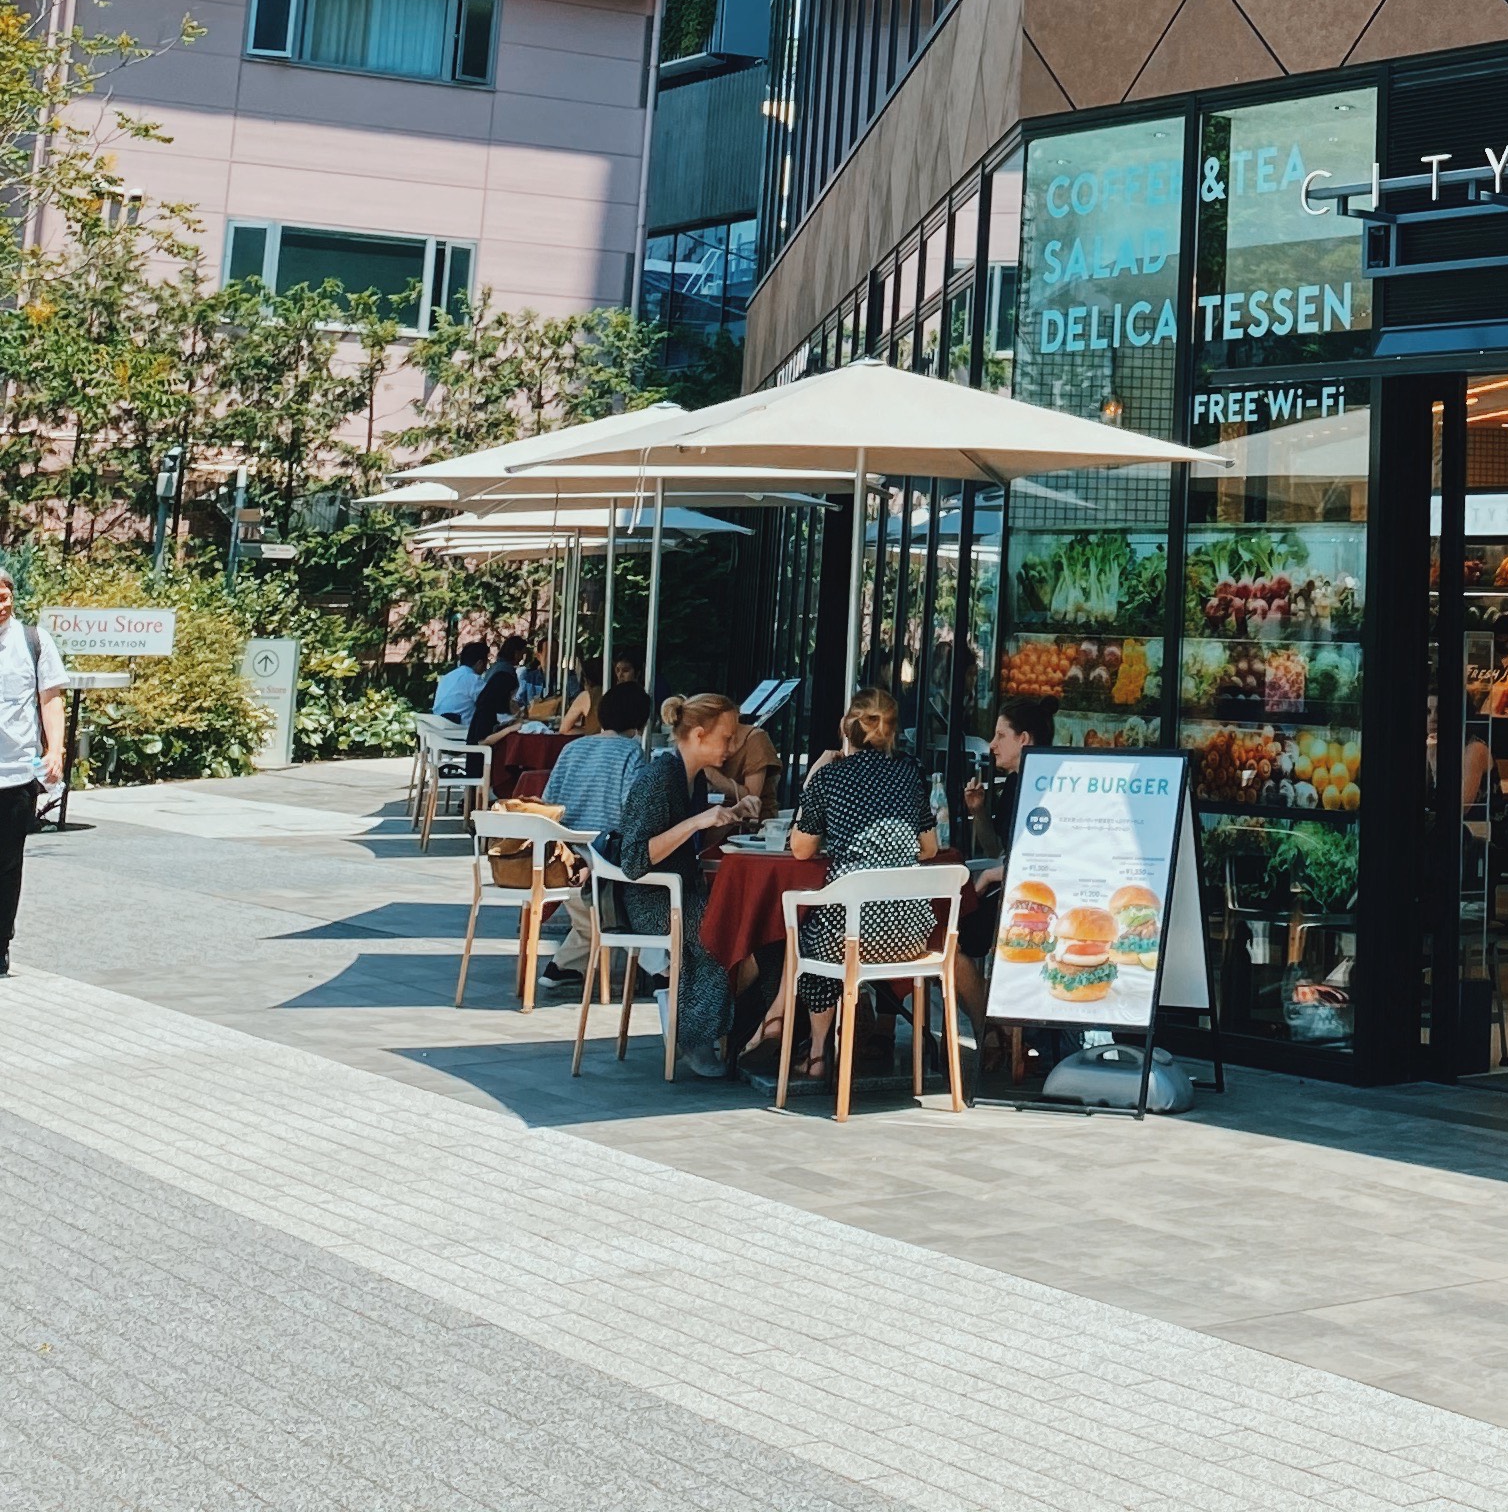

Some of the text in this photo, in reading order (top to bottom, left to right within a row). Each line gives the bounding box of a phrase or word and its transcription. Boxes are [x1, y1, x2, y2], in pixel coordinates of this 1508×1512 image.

[1042, 229, 1168, 284] SALAD
[1193, 385, 1345, 425] FREE Wi-Fi
[48, 614, 163, 636] Tokyu Store
[1034, 775, 1169, 795] CITY BURGER
